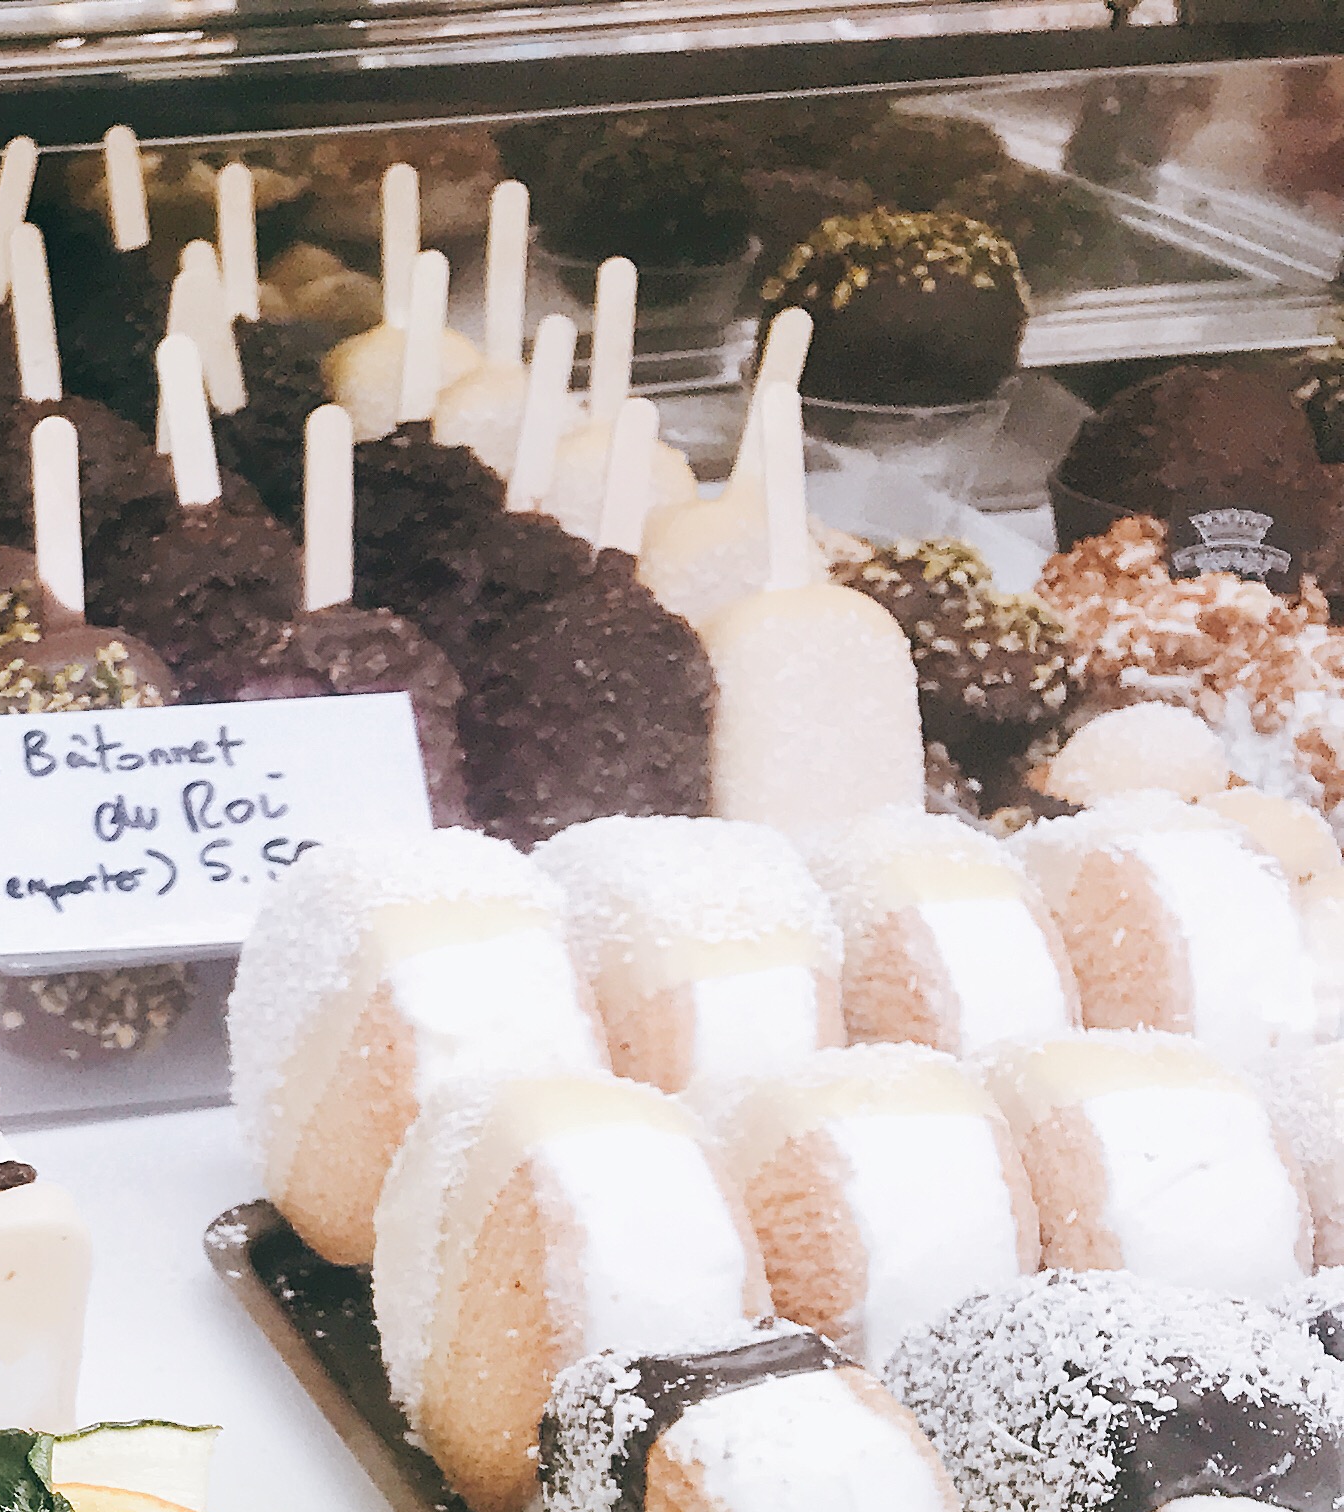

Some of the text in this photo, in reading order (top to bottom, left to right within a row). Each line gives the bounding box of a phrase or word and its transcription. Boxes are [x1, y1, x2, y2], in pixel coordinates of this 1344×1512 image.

[23, 721, 246, 779] Bâtonnet
[92, 771, 290, 843] du Roi
